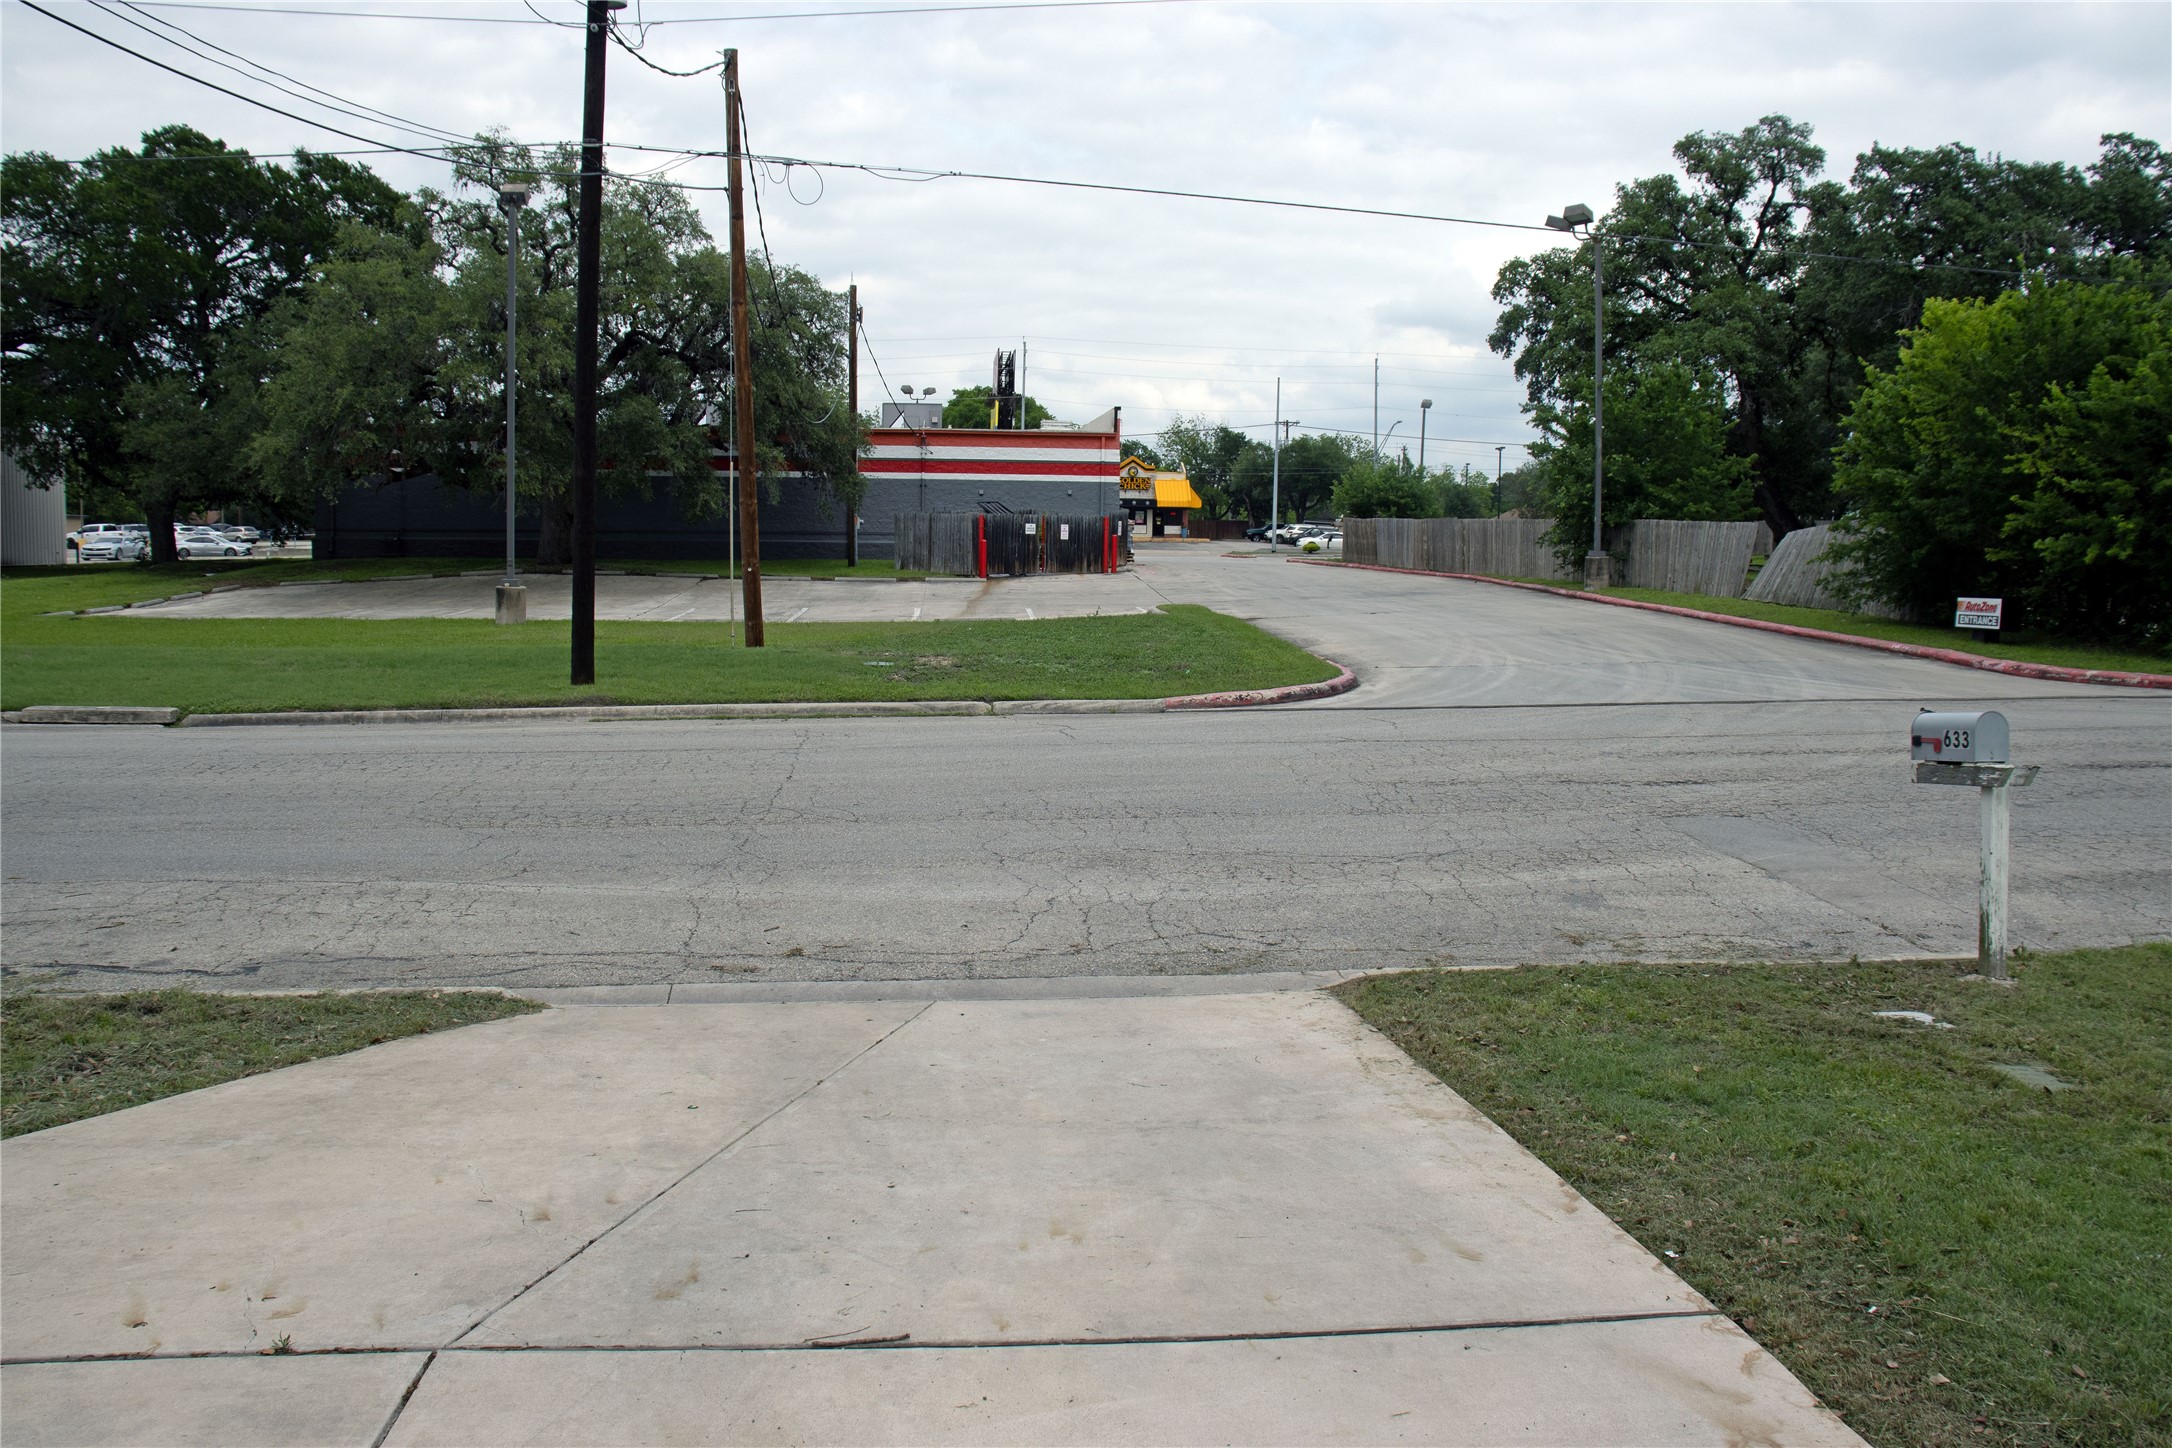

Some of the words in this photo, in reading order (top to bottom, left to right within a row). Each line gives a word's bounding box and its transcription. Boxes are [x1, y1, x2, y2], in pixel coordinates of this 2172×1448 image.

[1965, 601, 1997, 613] AutoZone
[1960, 615, 1998, 625] ENTRANCE
[1944, 730, 1969, 748] 633
